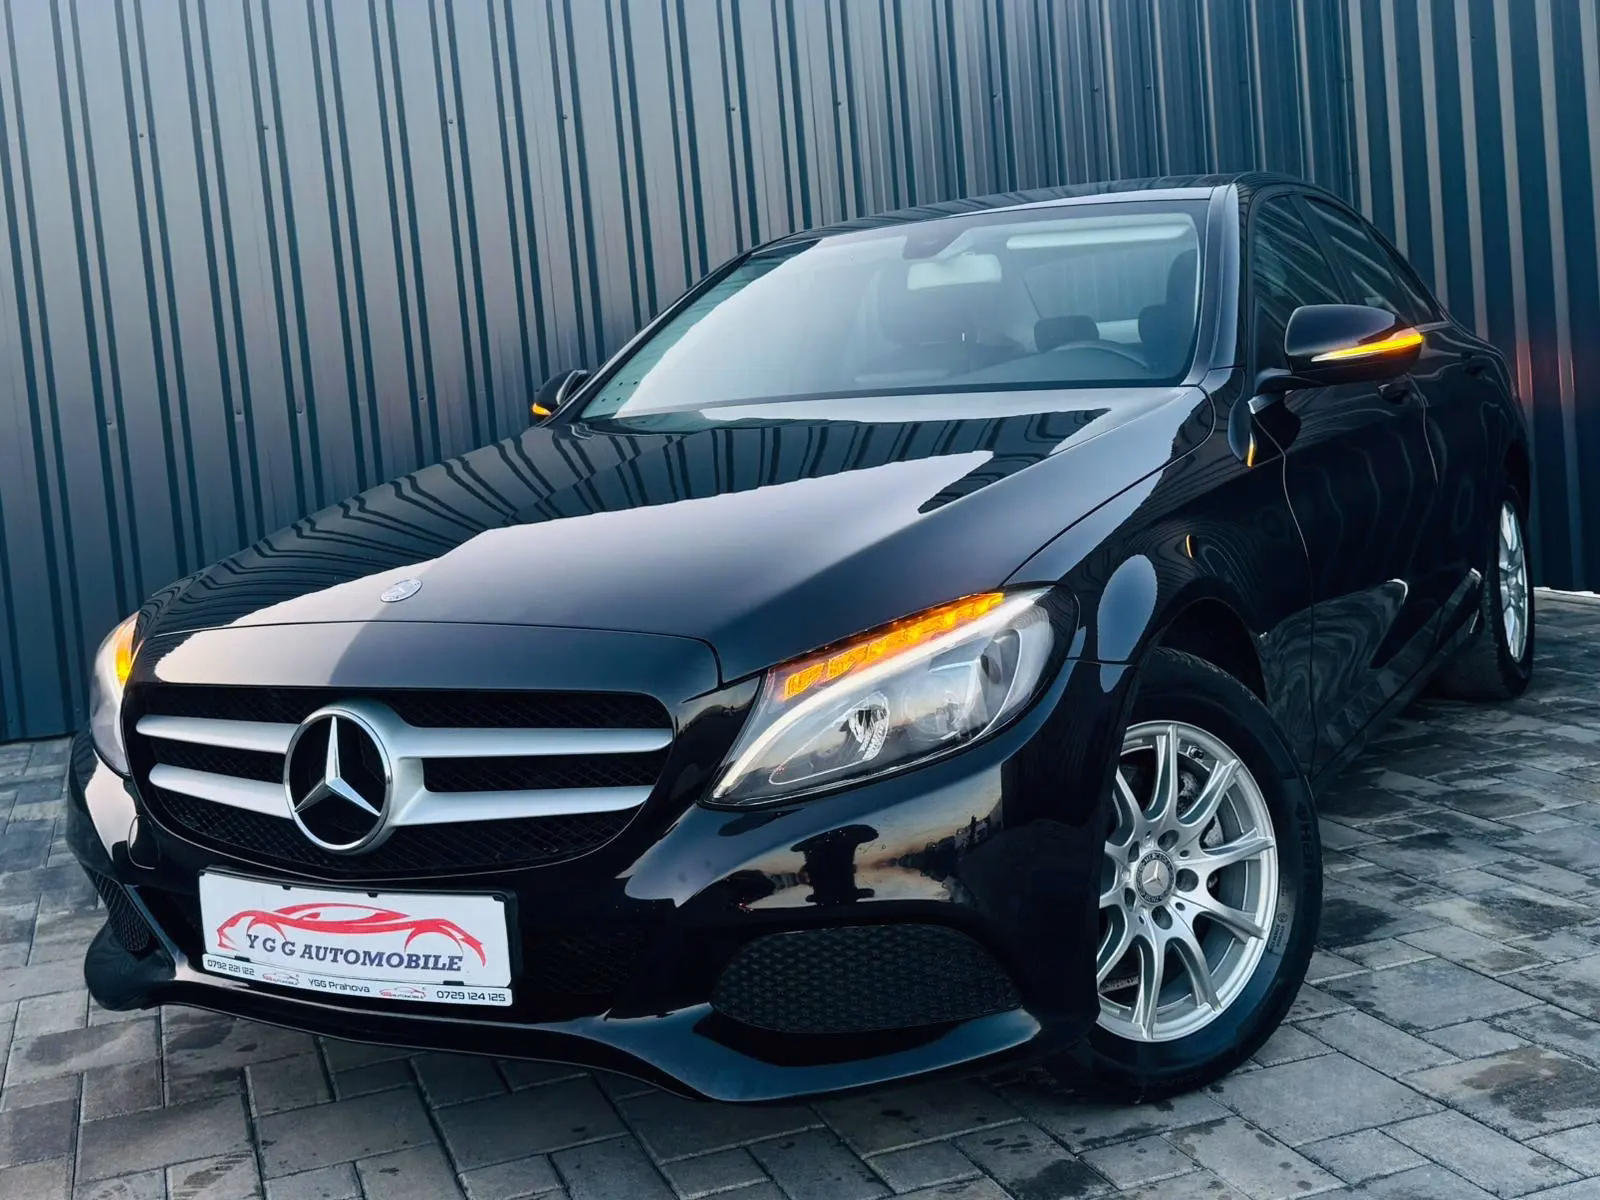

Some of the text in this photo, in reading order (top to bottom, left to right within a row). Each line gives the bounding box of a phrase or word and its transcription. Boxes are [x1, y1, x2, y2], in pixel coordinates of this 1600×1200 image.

[299, 944, 463, 971] AUTOMOBILE
[207, 960, 227, 970] 0792
[308, 977, 327, 988] YGG
[329, 980, 370, 992] Prahova
[436, 990, 506, 1002] 0729 124 125
